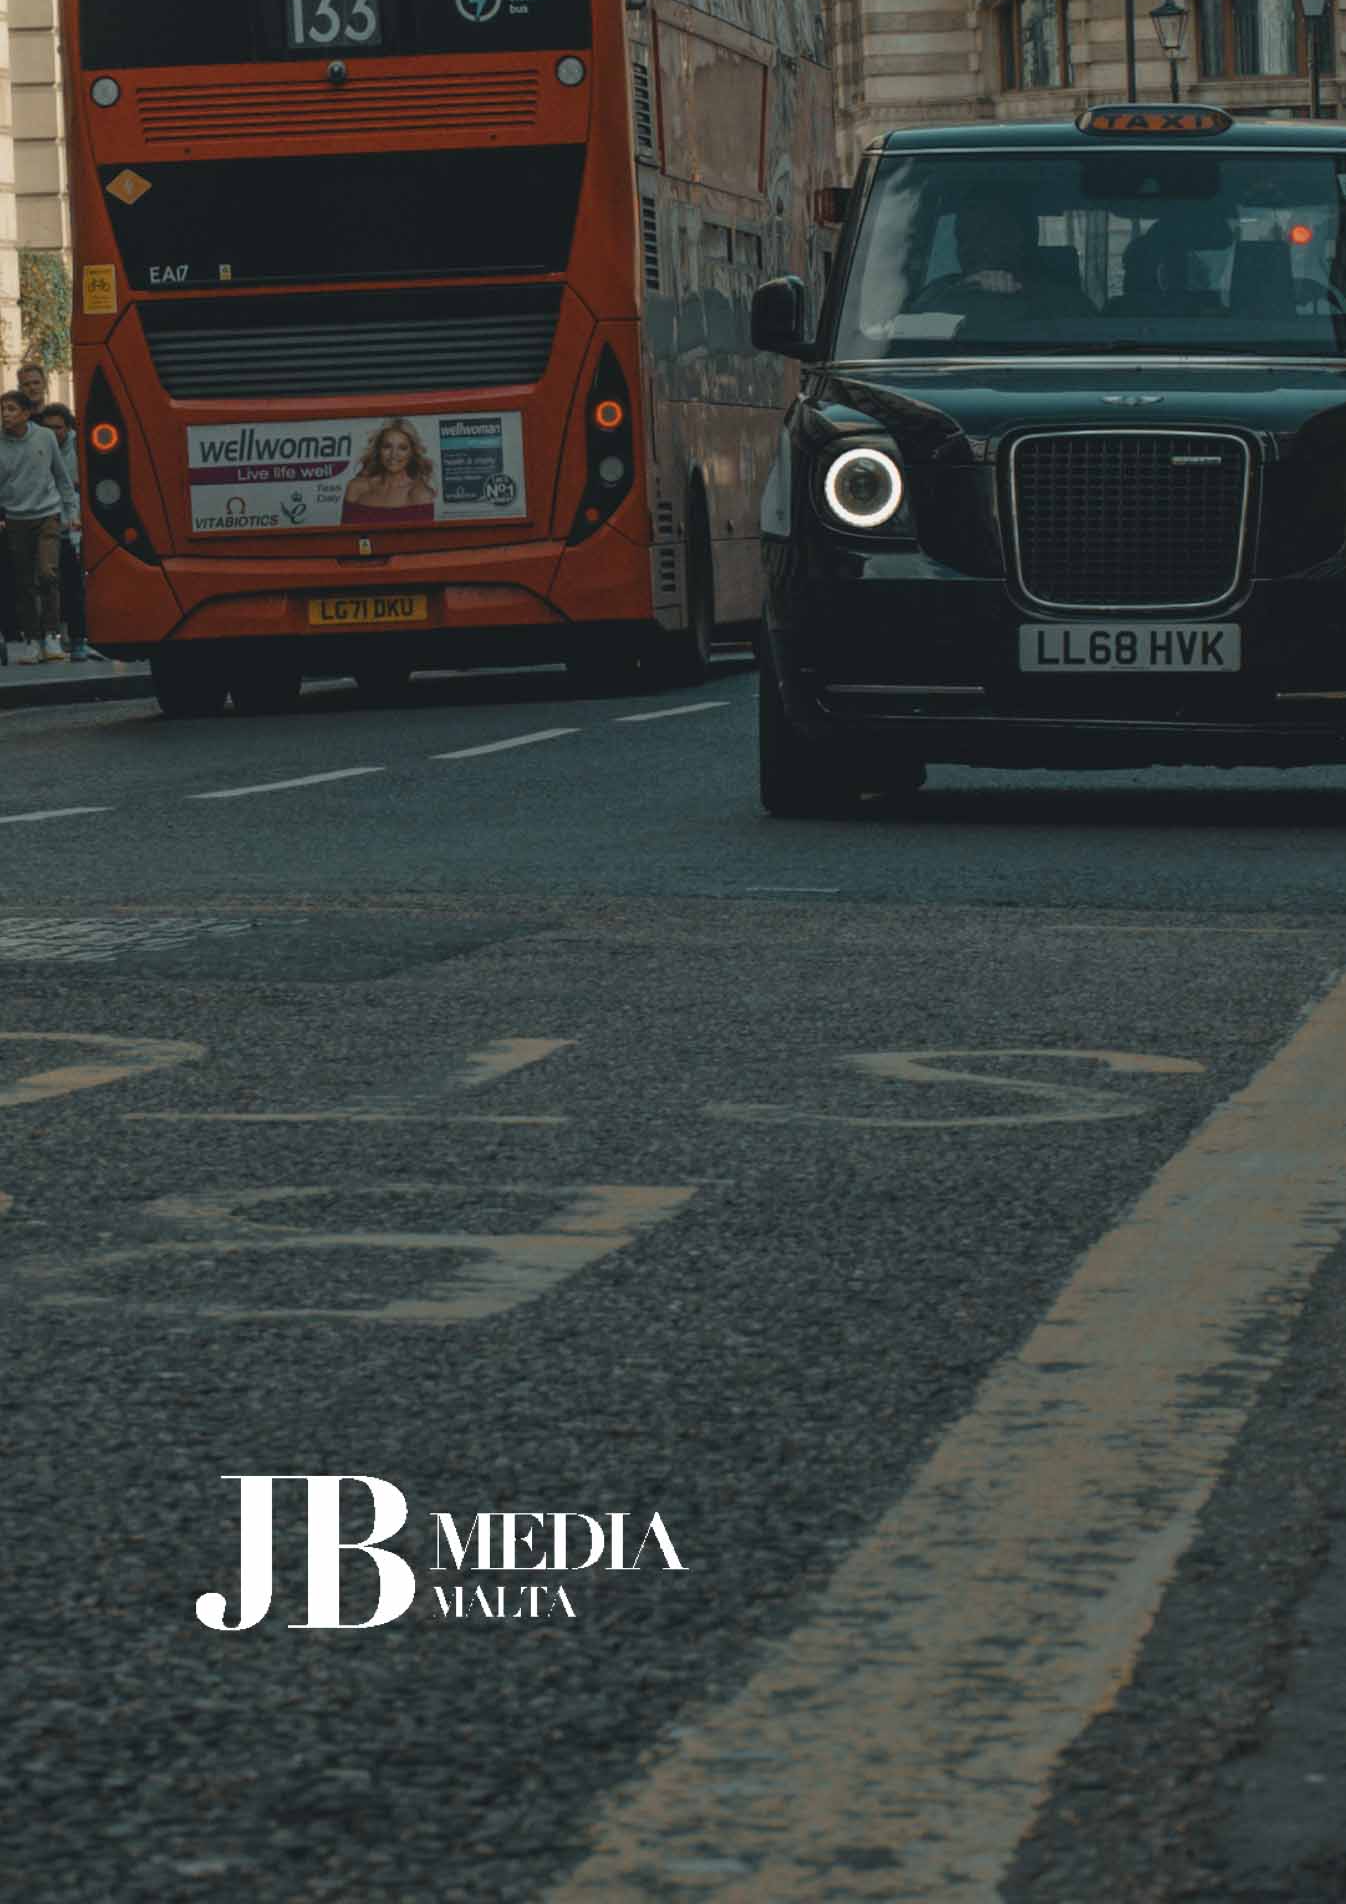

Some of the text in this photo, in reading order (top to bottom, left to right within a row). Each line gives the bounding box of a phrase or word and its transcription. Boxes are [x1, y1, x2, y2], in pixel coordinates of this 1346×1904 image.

[508, 3, 529, 15] bus
[1103, 113, 1202, 129] TAXI
[440, 421, 501, 436] wellwoman
[200, 427, 353, 463] wellwoman
[237, 462, 333, 482] Live life well
[195, 514, 280, 529] VITABIOTICS
[320, 598, 413, 620] LG71 DKU
[1037, 629, 1224, 665] LL68 HVK
